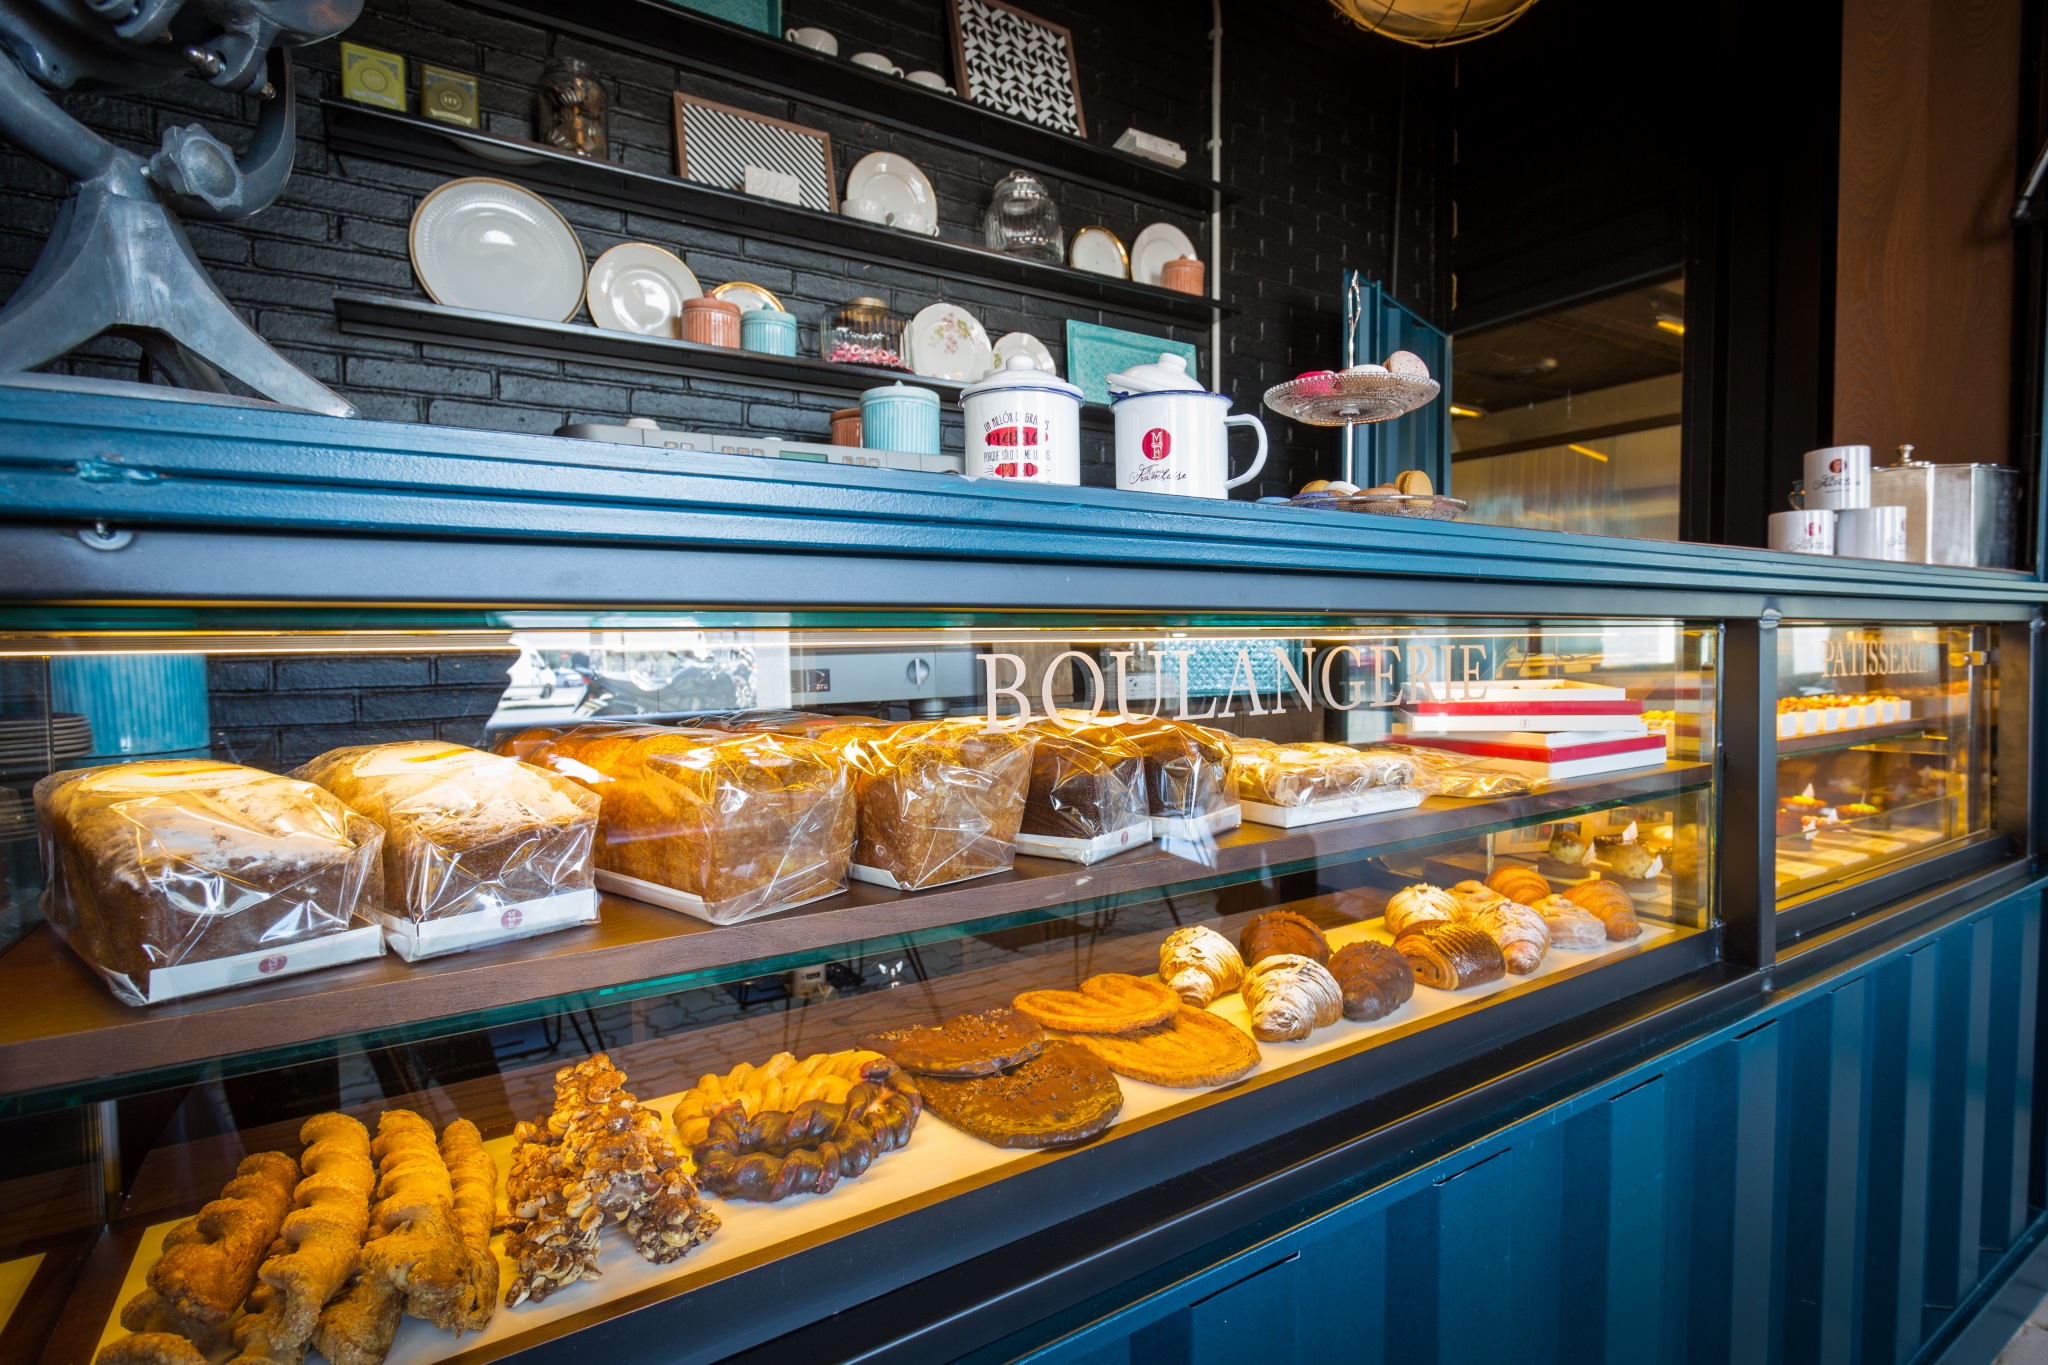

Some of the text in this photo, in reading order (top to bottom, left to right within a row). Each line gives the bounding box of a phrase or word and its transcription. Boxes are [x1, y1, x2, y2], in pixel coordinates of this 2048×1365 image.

[999, 463, 1033, 478] TOO
[1129, 464, 1186, 484] Frambise
[1822, 640, 1929, 678] PATISSERIE
[976, 644, 1488, 735] BOULANGERIE
